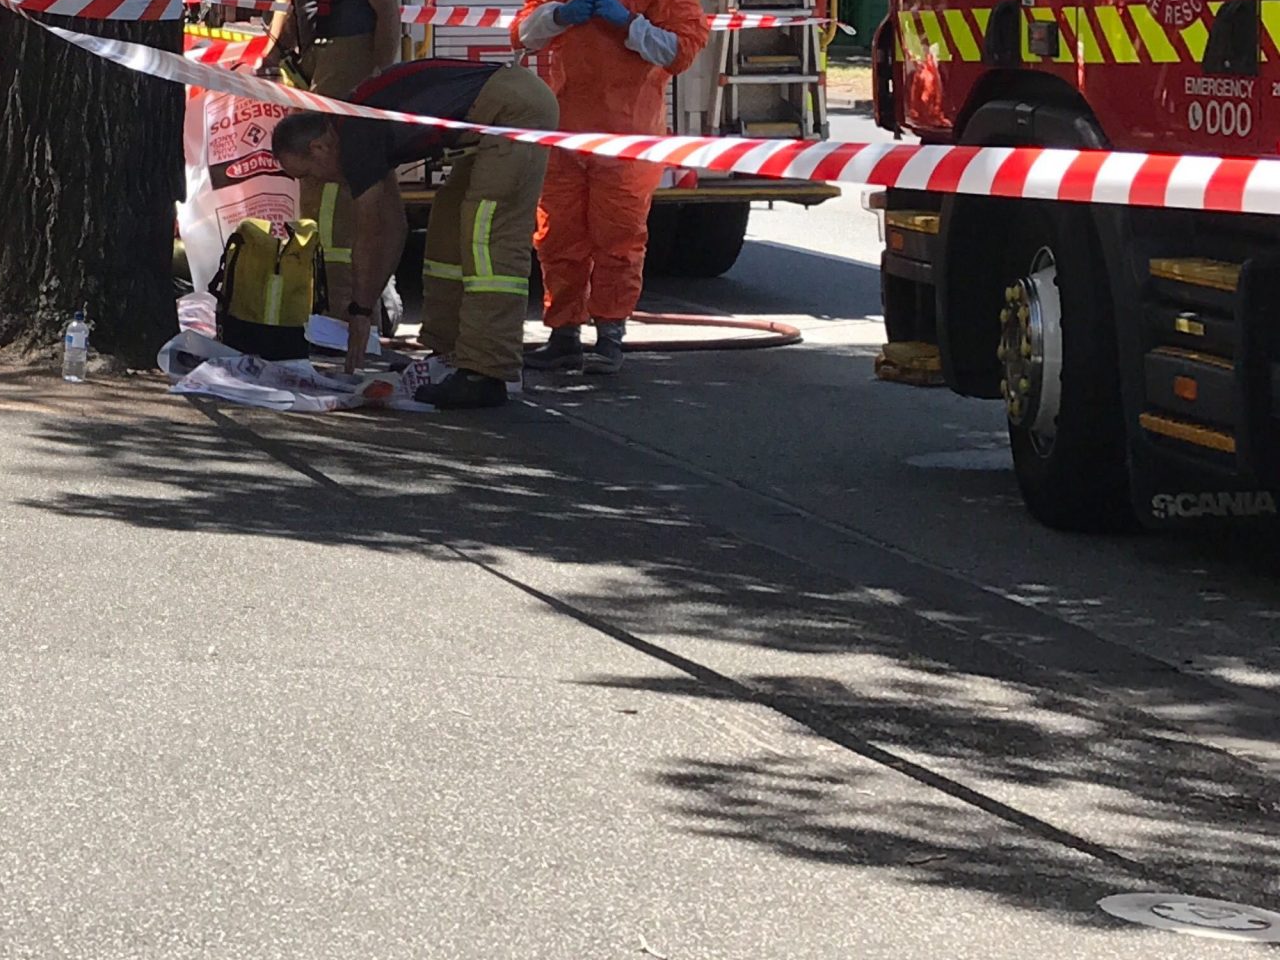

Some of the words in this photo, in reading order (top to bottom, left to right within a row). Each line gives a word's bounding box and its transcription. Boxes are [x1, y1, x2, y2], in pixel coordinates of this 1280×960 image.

[1185, 76, 1254, 98] EMERGENCY
[210, 103, 289, 136] ASBESTOS
[1206, 100, 1251, 137] 000
[233, 154, 282, 175] DANGER
[1151, 492, 1277, 519] SCANIA
